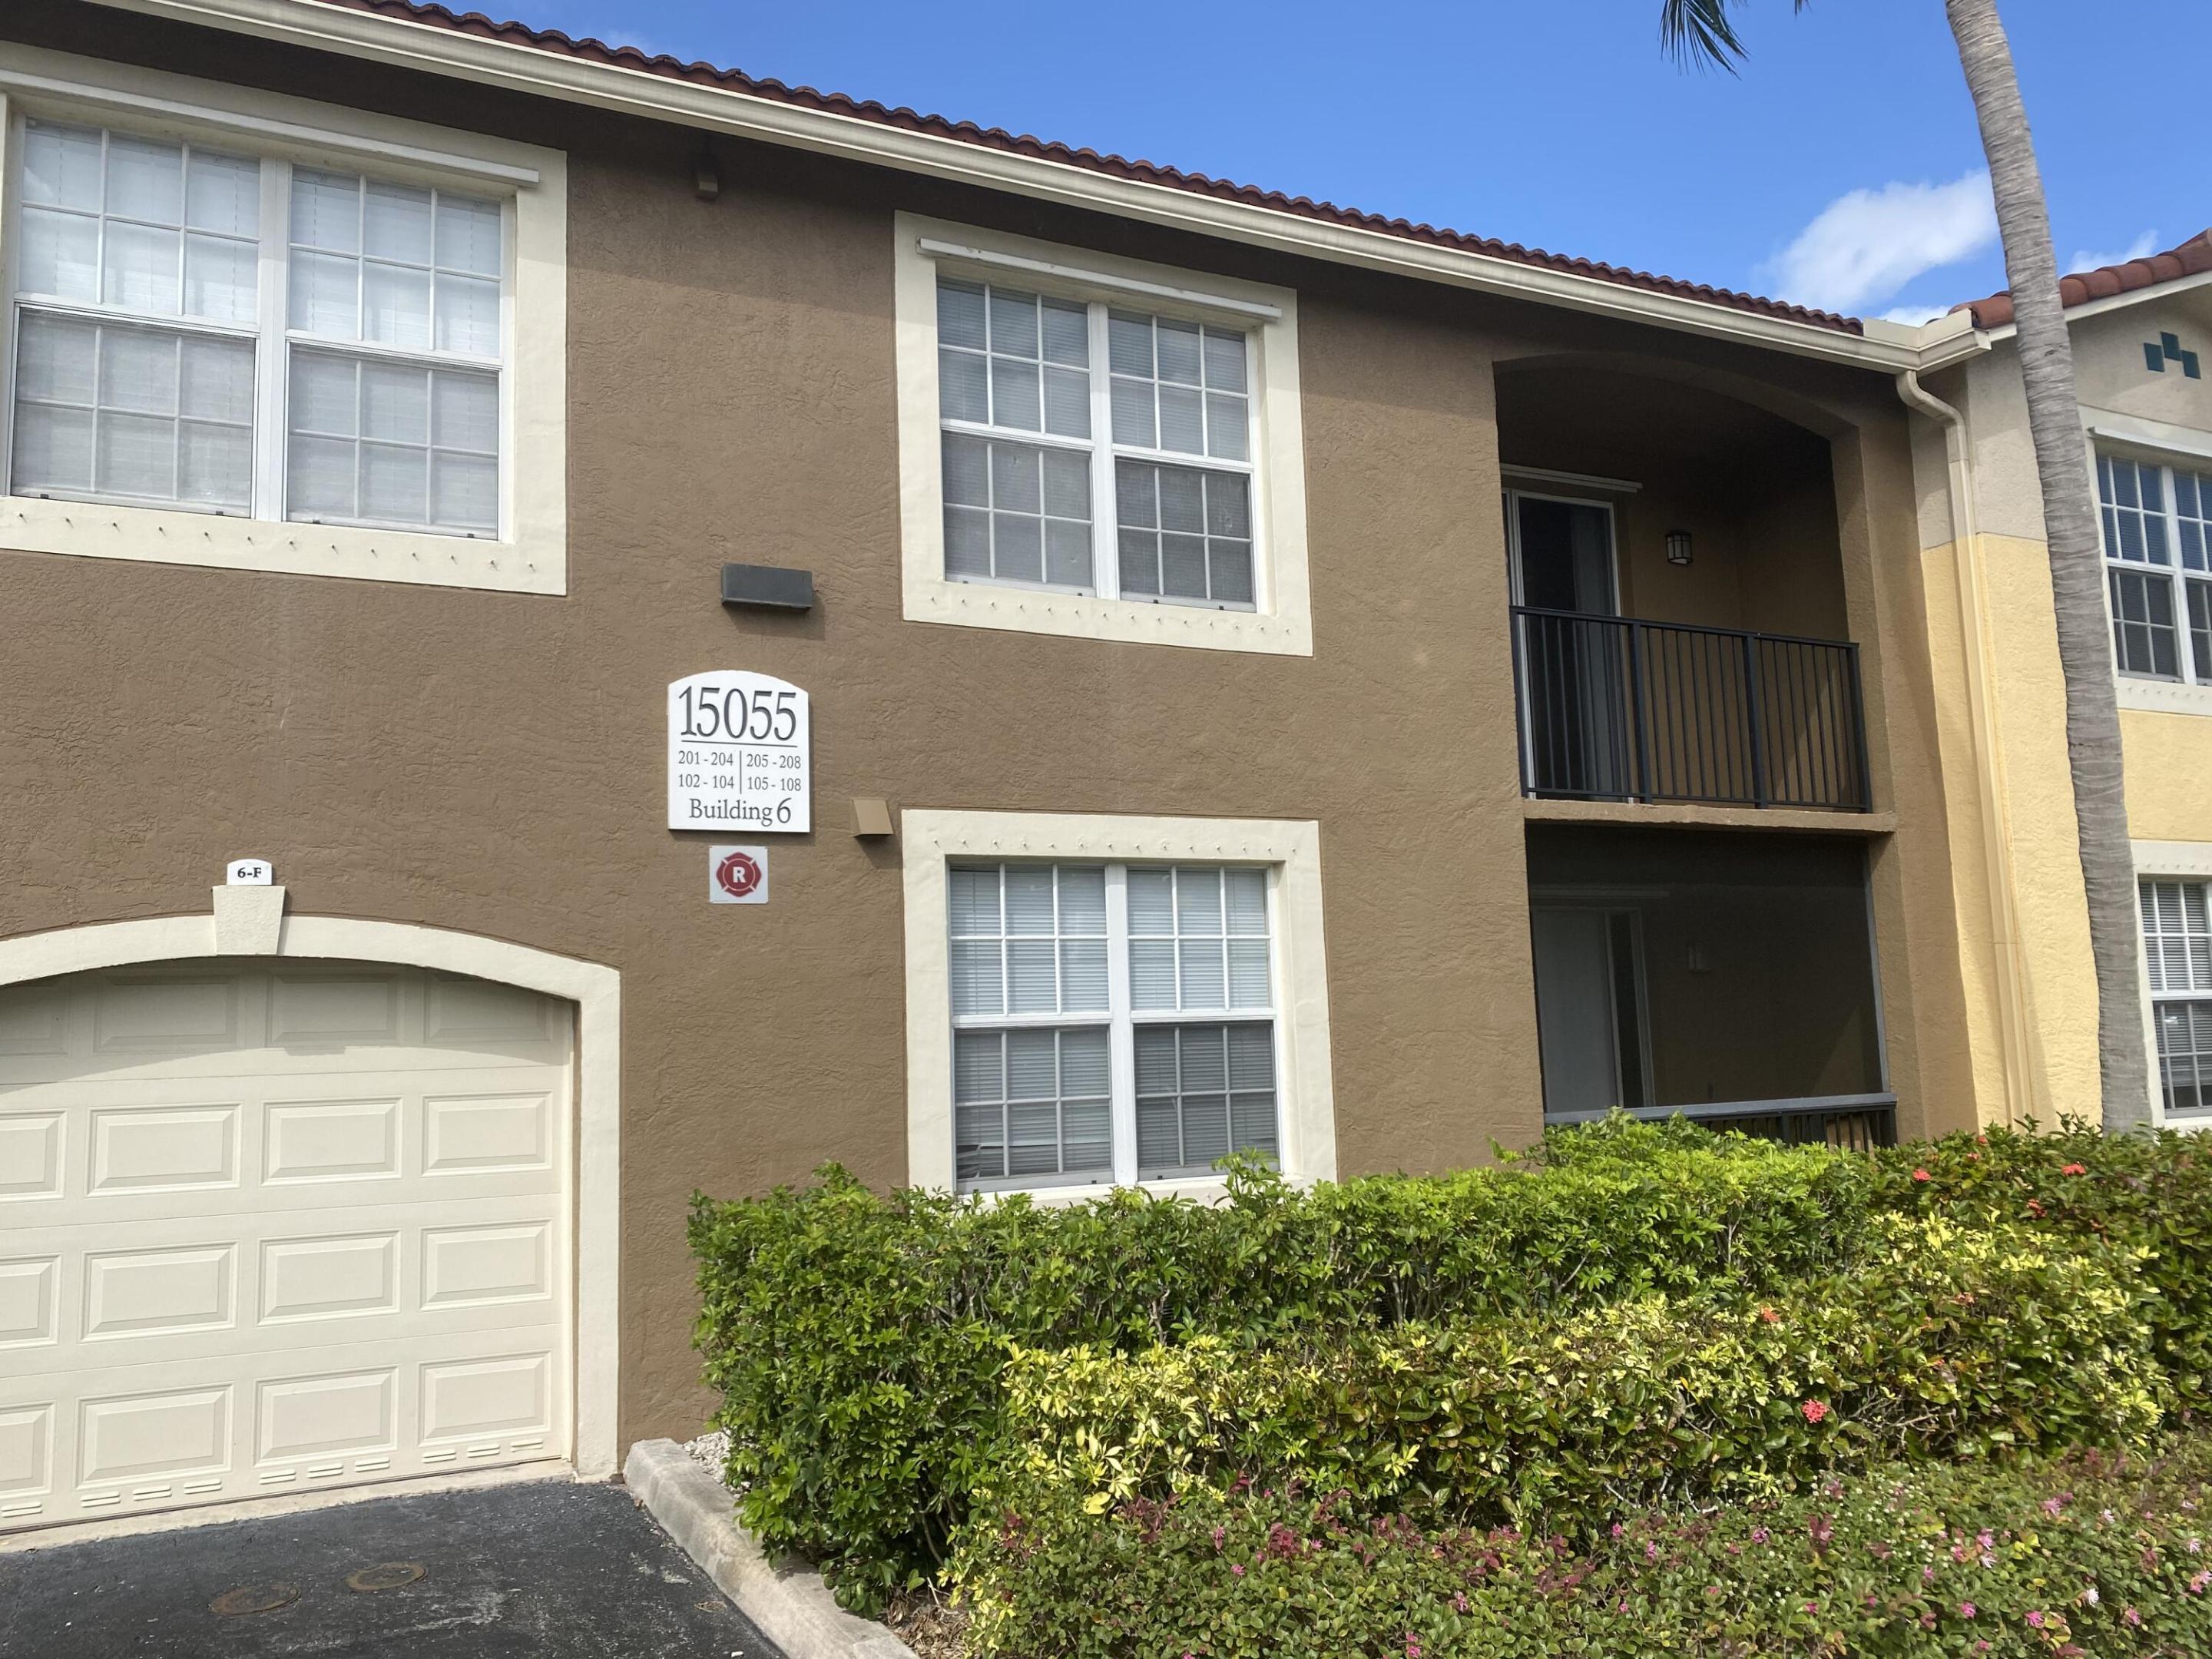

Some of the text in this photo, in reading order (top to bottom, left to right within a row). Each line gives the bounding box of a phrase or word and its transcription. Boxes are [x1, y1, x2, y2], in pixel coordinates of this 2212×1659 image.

[679, 685, 796, 741] 15055
[678, 750, 700, 765] 201
[710, 752, 733, 766] 204
[747, 753, 769, 767] 205
[780, 755, 801, 769] 208
[678, 774, 700, 787] 102
[713, 775, 734, 789] 104
[747, 777, 769, 790] 105
[780, 777, 801, 791] 108
[689, 797, 792, 827] Building 6
[237, 867, 262, 878] 6-F
[733, 866, 747, 883] R
